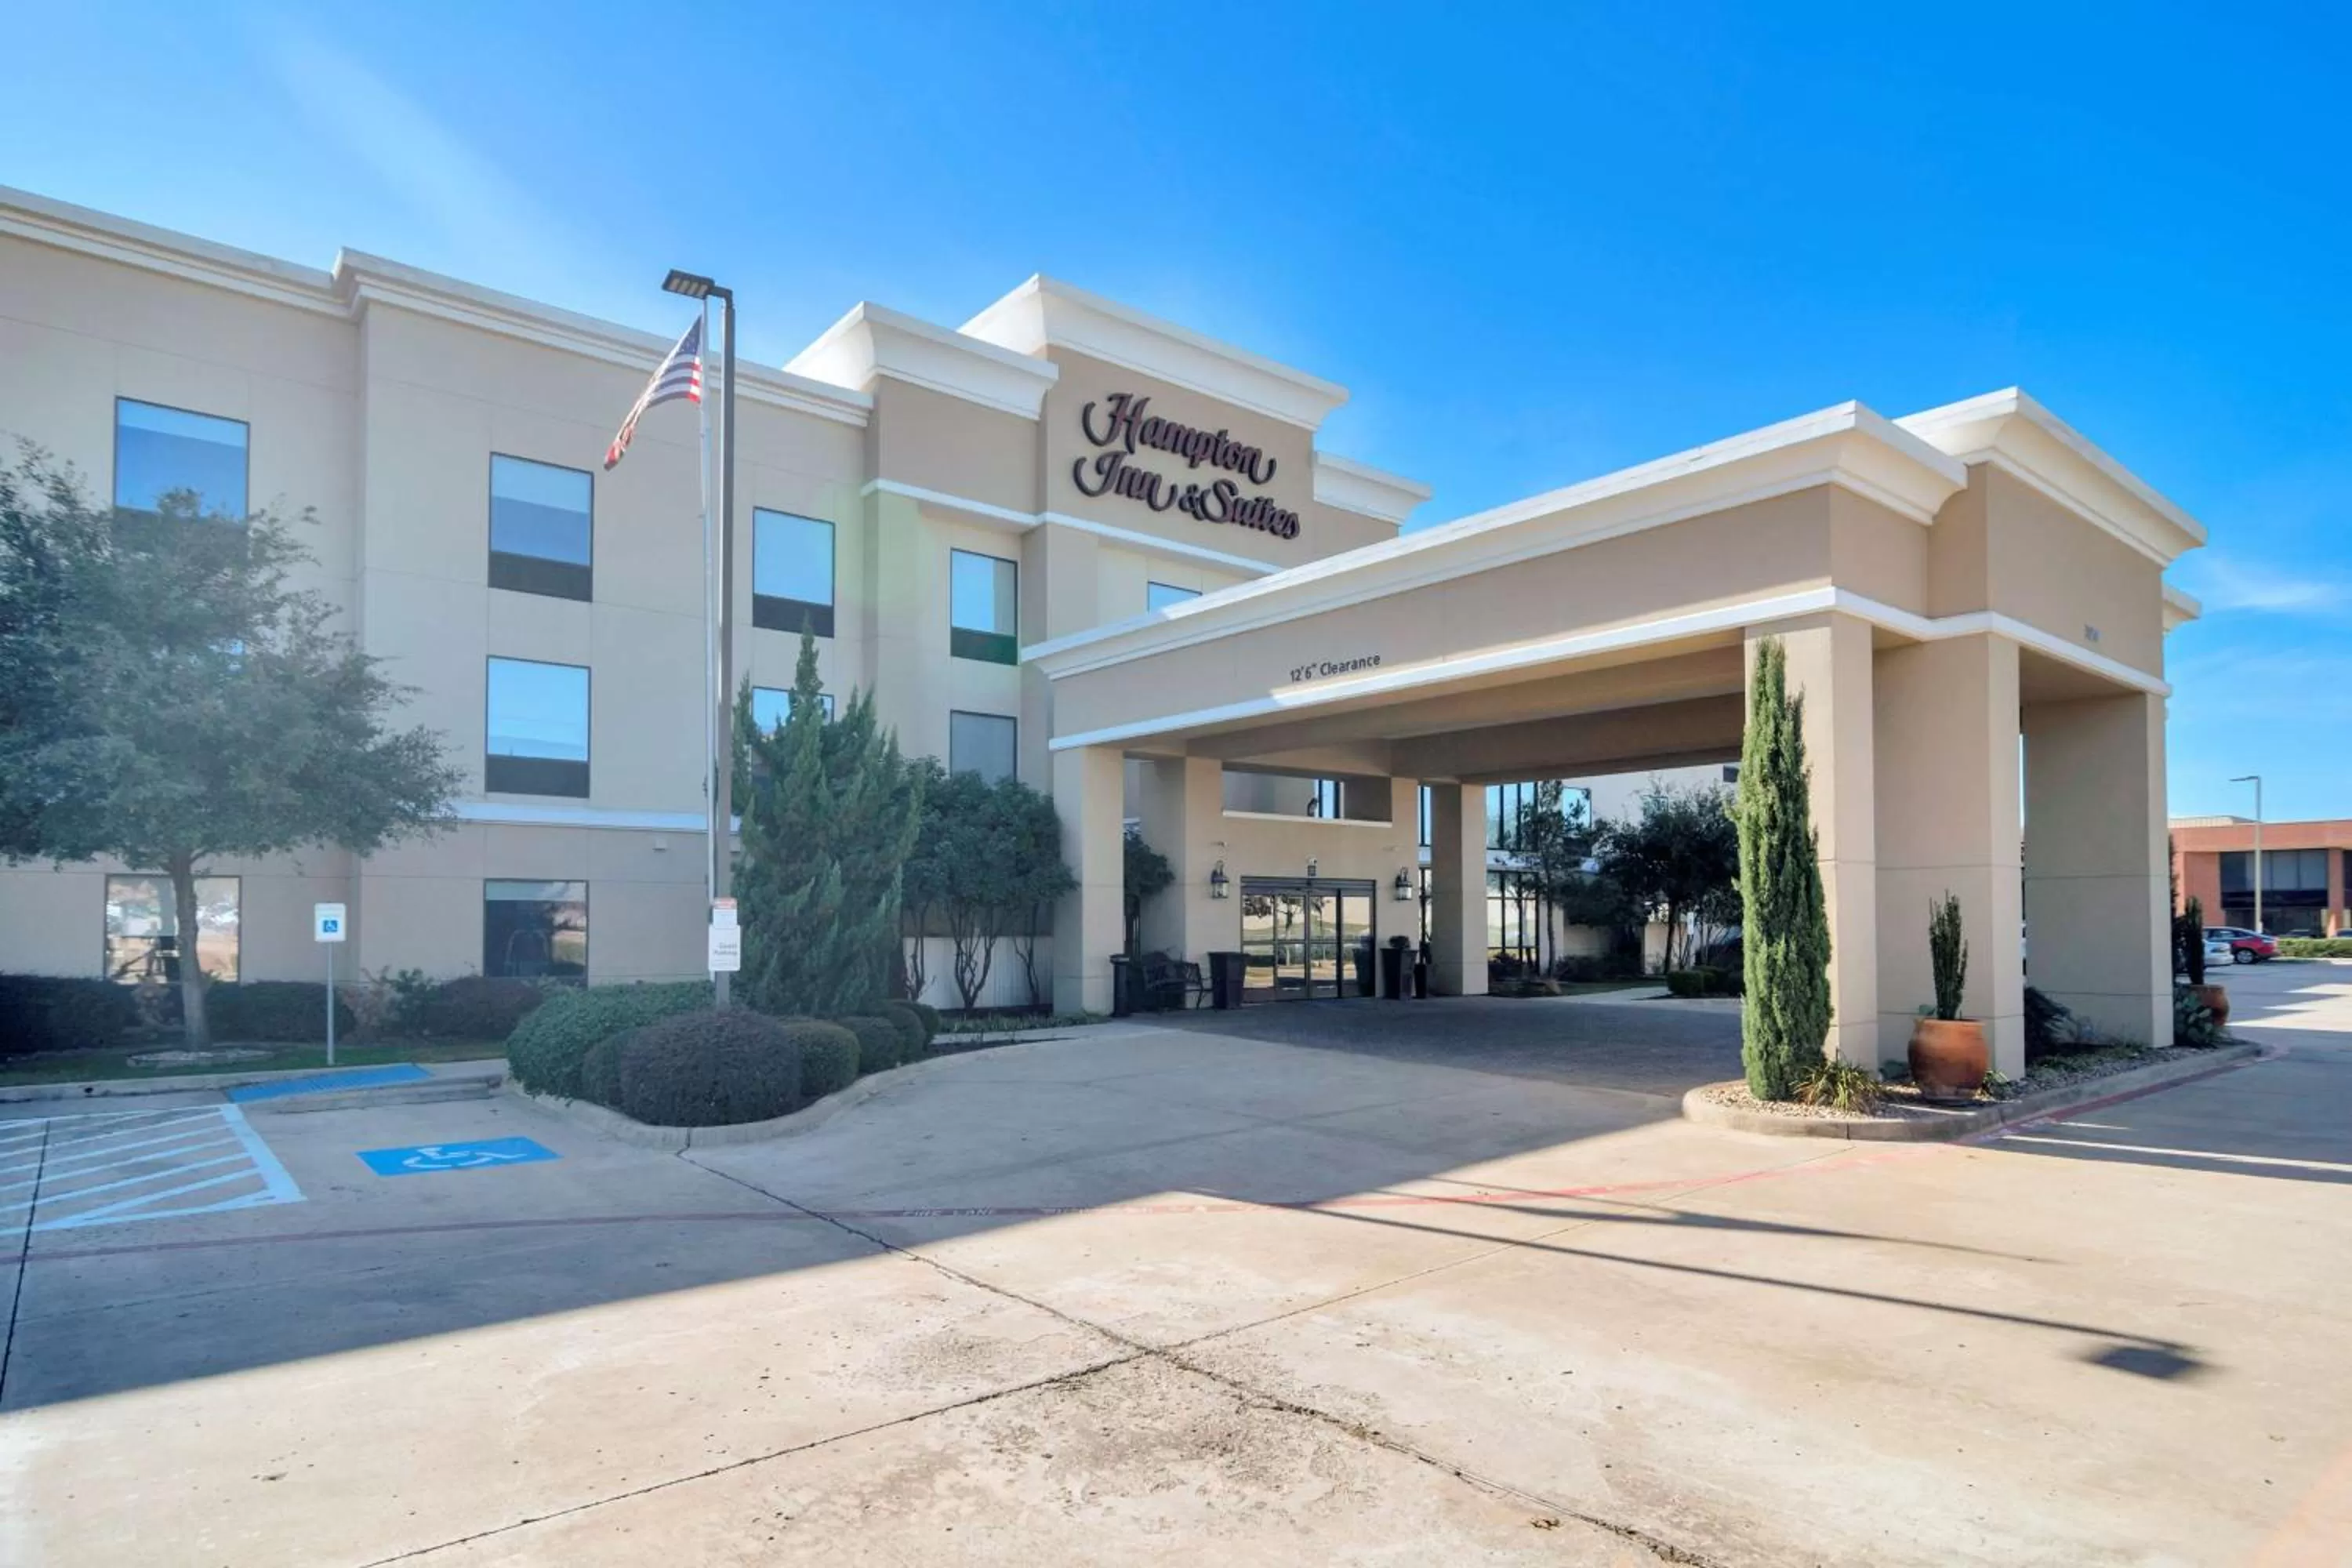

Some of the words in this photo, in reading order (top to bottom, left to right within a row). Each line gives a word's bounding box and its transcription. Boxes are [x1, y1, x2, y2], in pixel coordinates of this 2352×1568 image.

[1081, 393, 1277, 485] Hampton
[1073, 450, 1178, 512] Inn
[1178, 483, 1205, 521] &
[1200, 478, 1301, 539] Suites
[1319, 652, 1381, 677] Clearance
